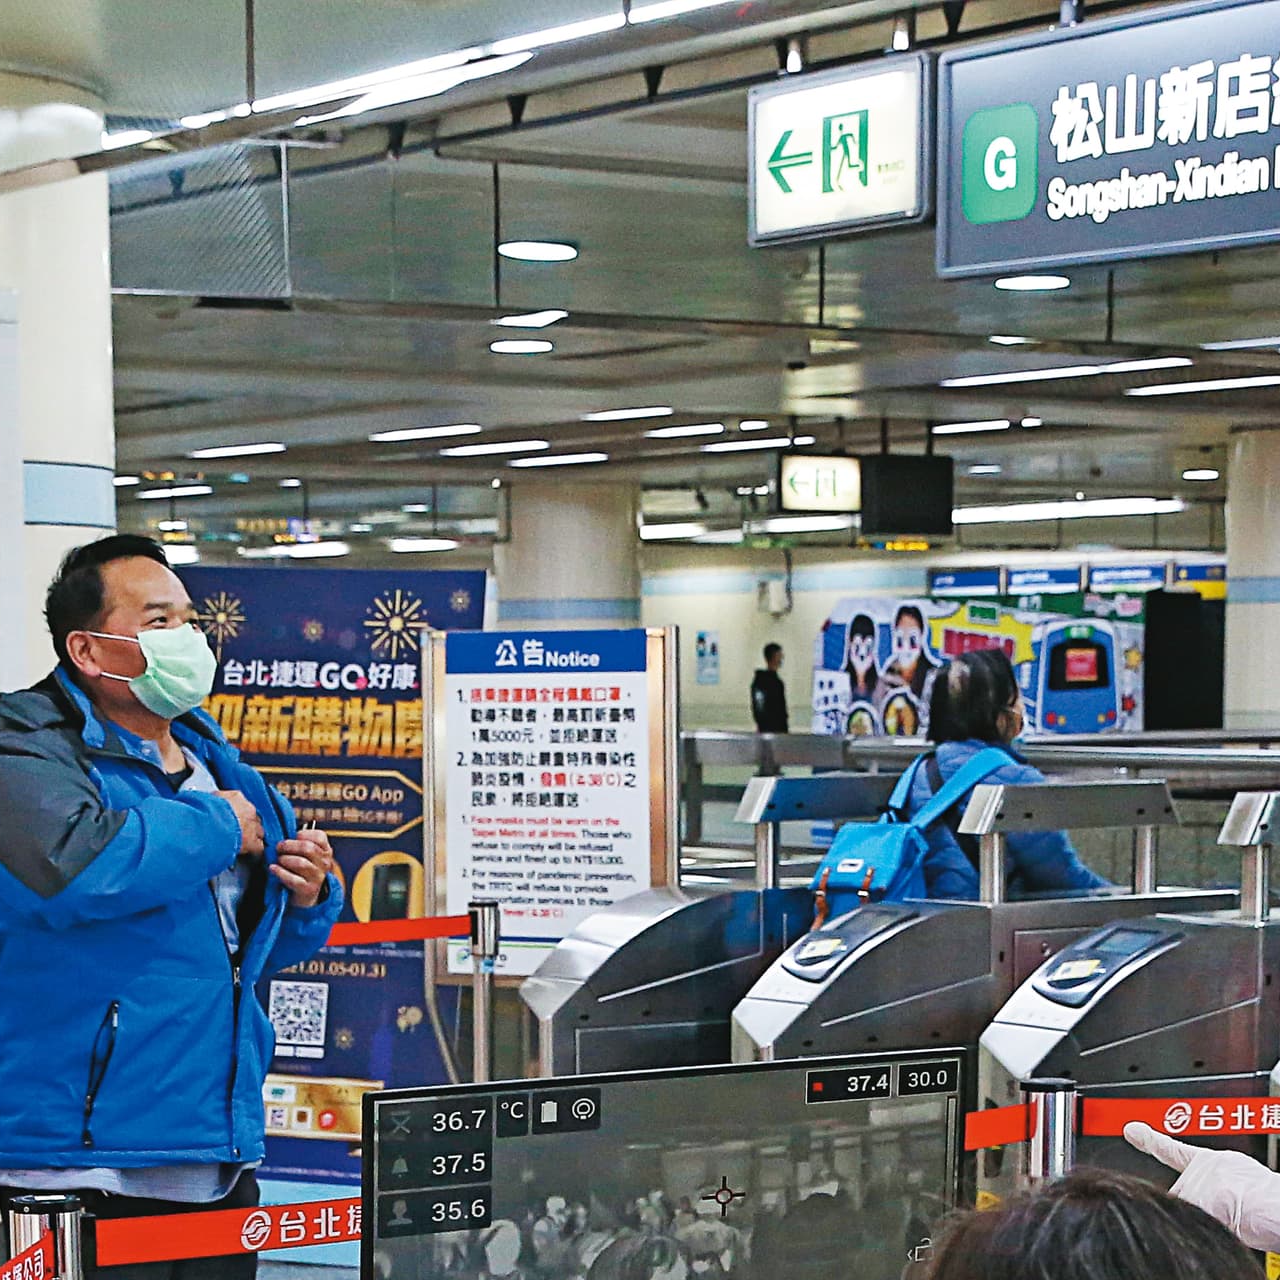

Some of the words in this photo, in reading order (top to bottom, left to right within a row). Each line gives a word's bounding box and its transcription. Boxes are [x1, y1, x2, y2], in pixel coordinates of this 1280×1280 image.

[983, 136, 1018, 192] G
[1046, 151, 1271, 224] Songshan-Xindian
[495, 638, 545, 667] 公告
[545, 650, 601, 668] Notice
[370, 785, 405, 804] App
[471, 854, 503, 863] service
[846, 1073, 889, 1094] 37.4
[907, 1069, 948, 1089] 30.0
[431, 1109, 486, 1133] 36.7
[500, 1101, 525, 1121] °C
[431, 1152, 486, 1176] 37.5
[431, 1198, 486, 1222] 35.6
